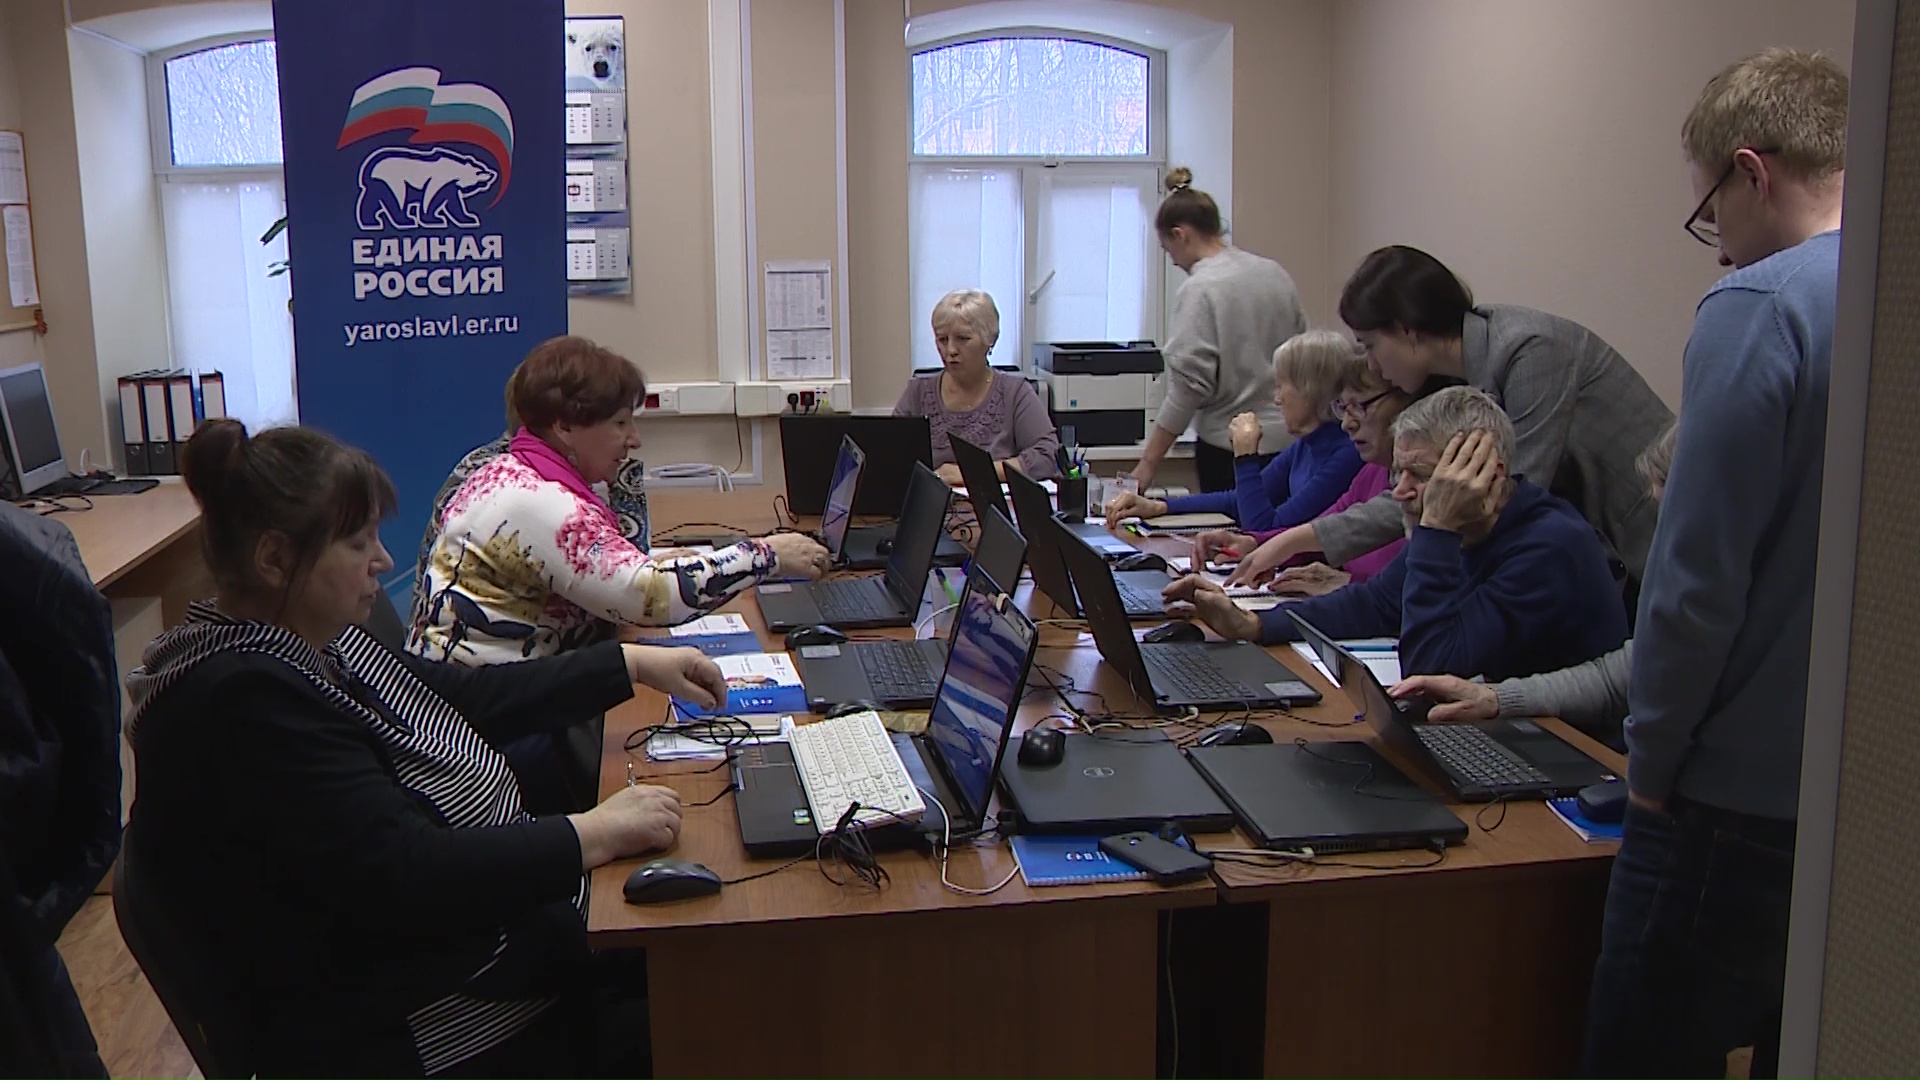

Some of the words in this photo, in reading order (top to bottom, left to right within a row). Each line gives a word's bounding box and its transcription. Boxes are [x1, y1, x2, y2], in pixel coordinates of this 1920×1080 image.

[352, 235, 503, 268] ЕДИНАЯ
[354, 266, 504, 300] РОССИЯ
[344, 315, 519, 346] yaroslavl.er.ru
